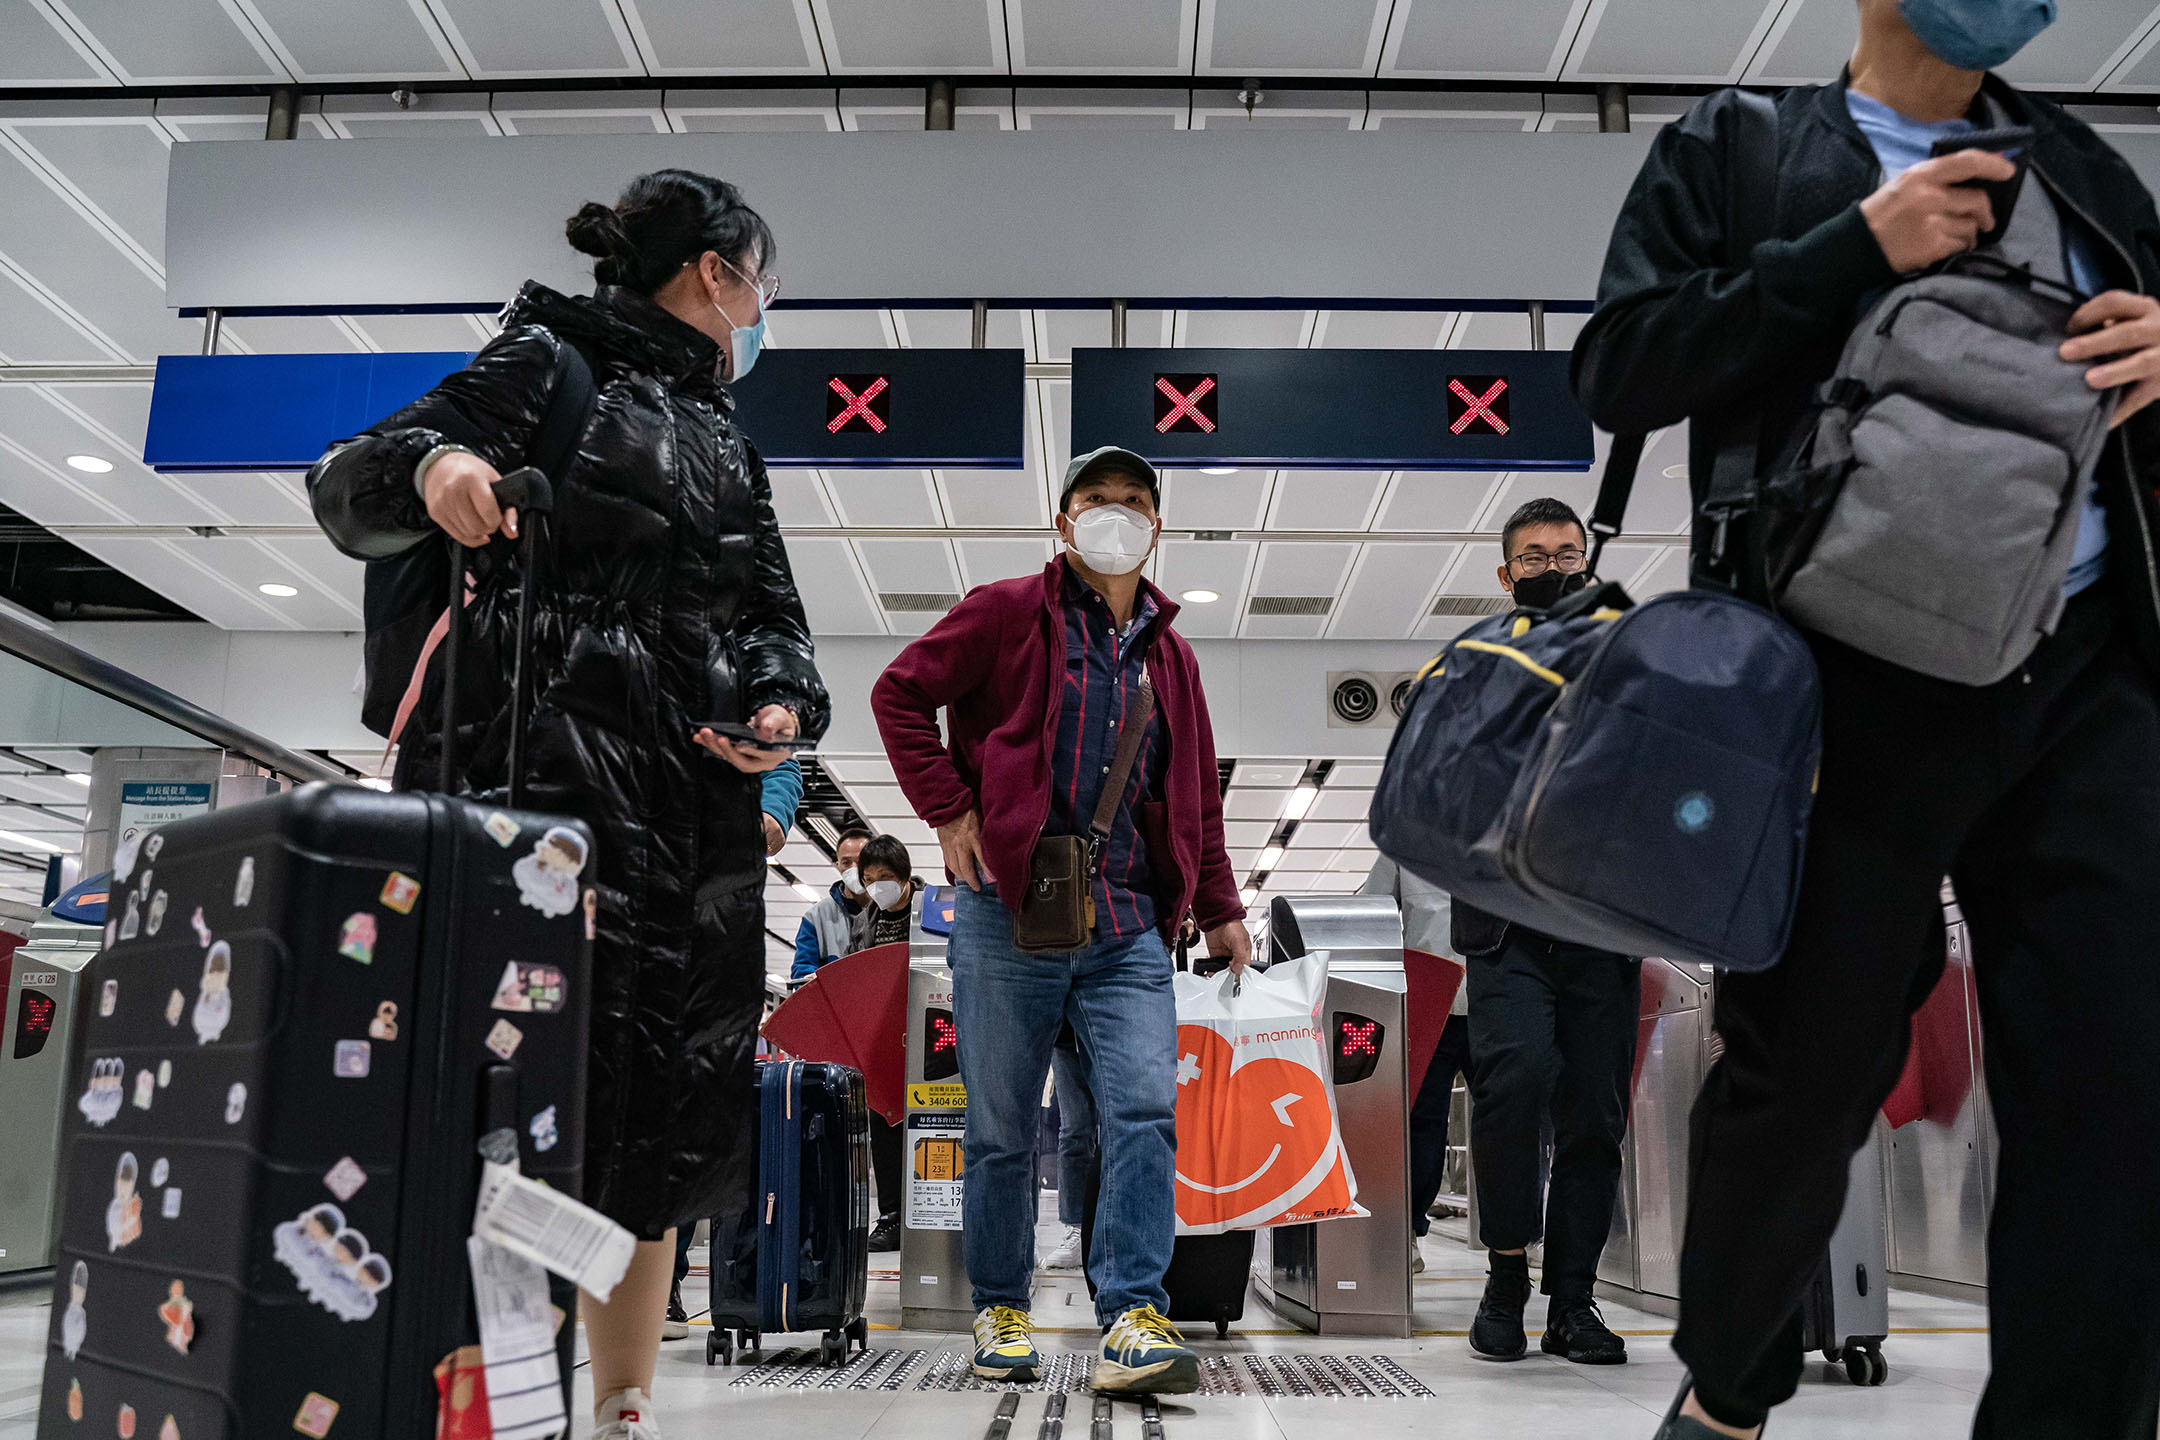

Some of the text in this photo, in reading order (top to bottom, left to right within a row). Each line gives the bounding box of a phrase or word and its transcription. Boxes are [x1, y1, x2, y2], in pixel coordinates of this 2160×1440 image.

[37, 975, 43, 984] G
[45, 975, 56, 984] 128
[929, 1097, 950, 1106] 3404
